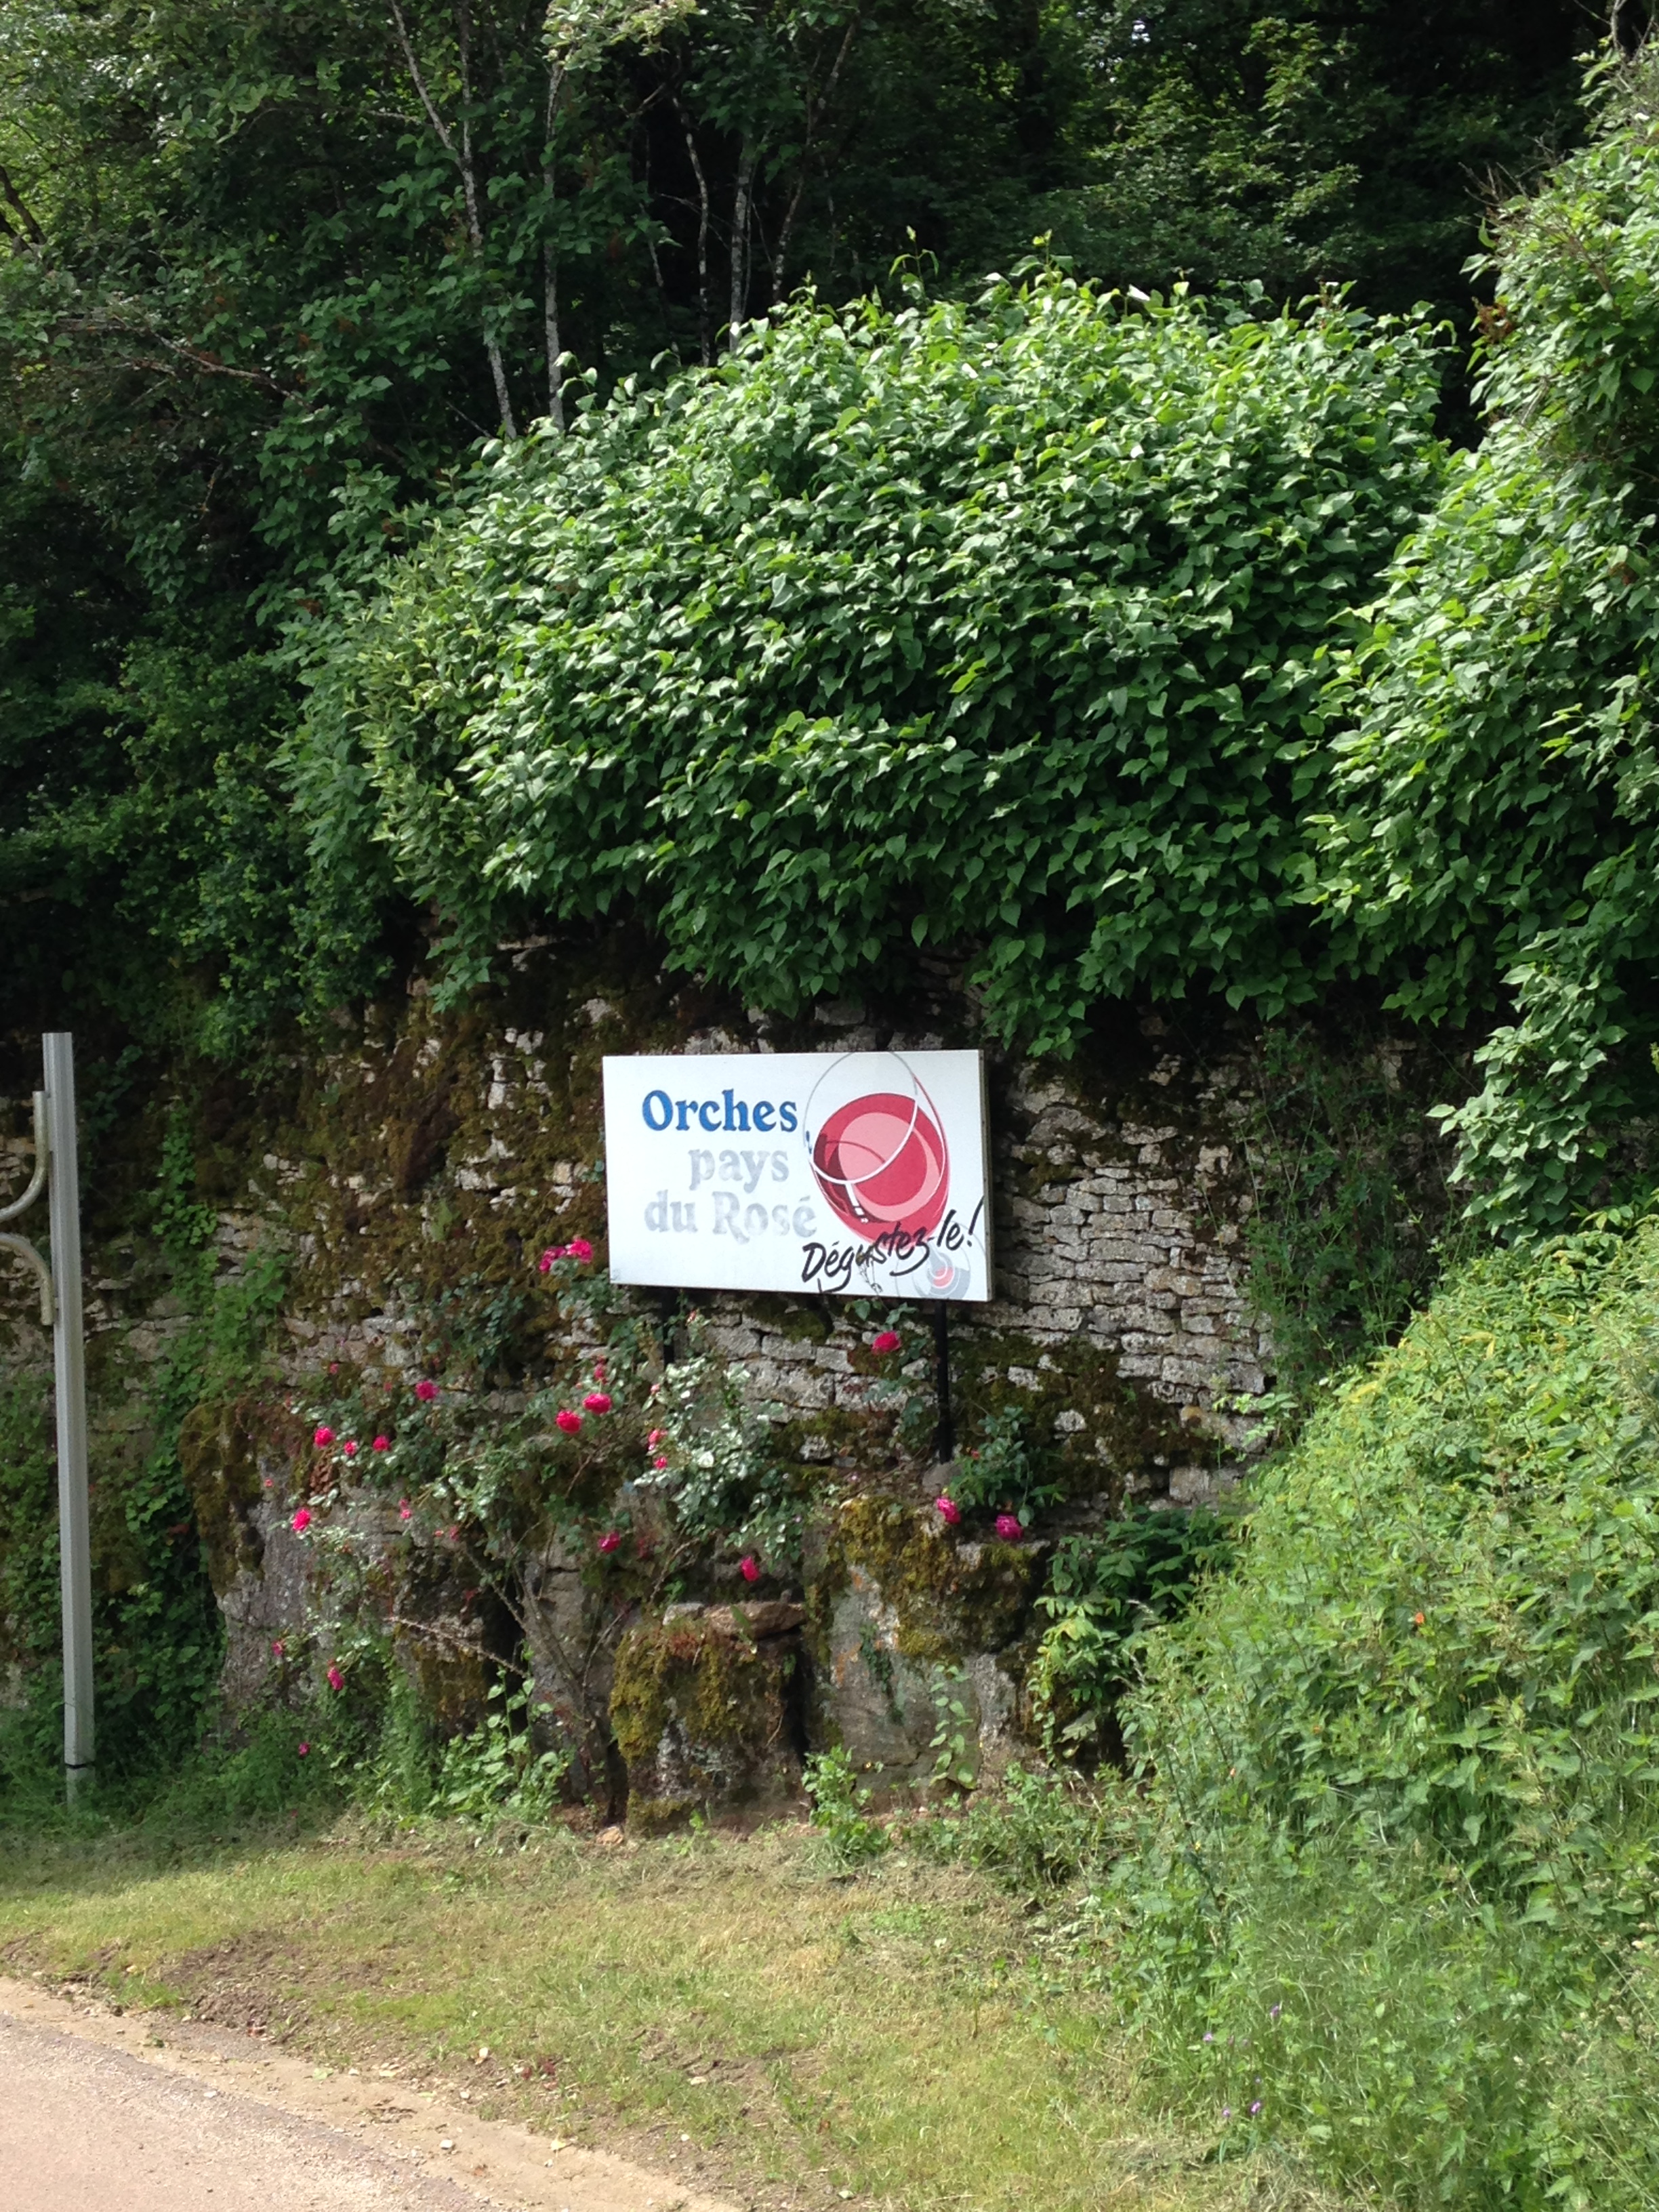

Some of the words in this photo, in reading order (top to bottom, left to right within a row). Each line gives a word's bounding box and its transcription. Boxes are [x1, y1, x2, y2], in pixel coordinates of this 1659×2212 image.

[642, 1088, 798, 1132] Orches
[688, 1149, 790, 1194] pays
[644, 1189, 698, 1233] du
[712, 1191, 817, 1245] Rosé
